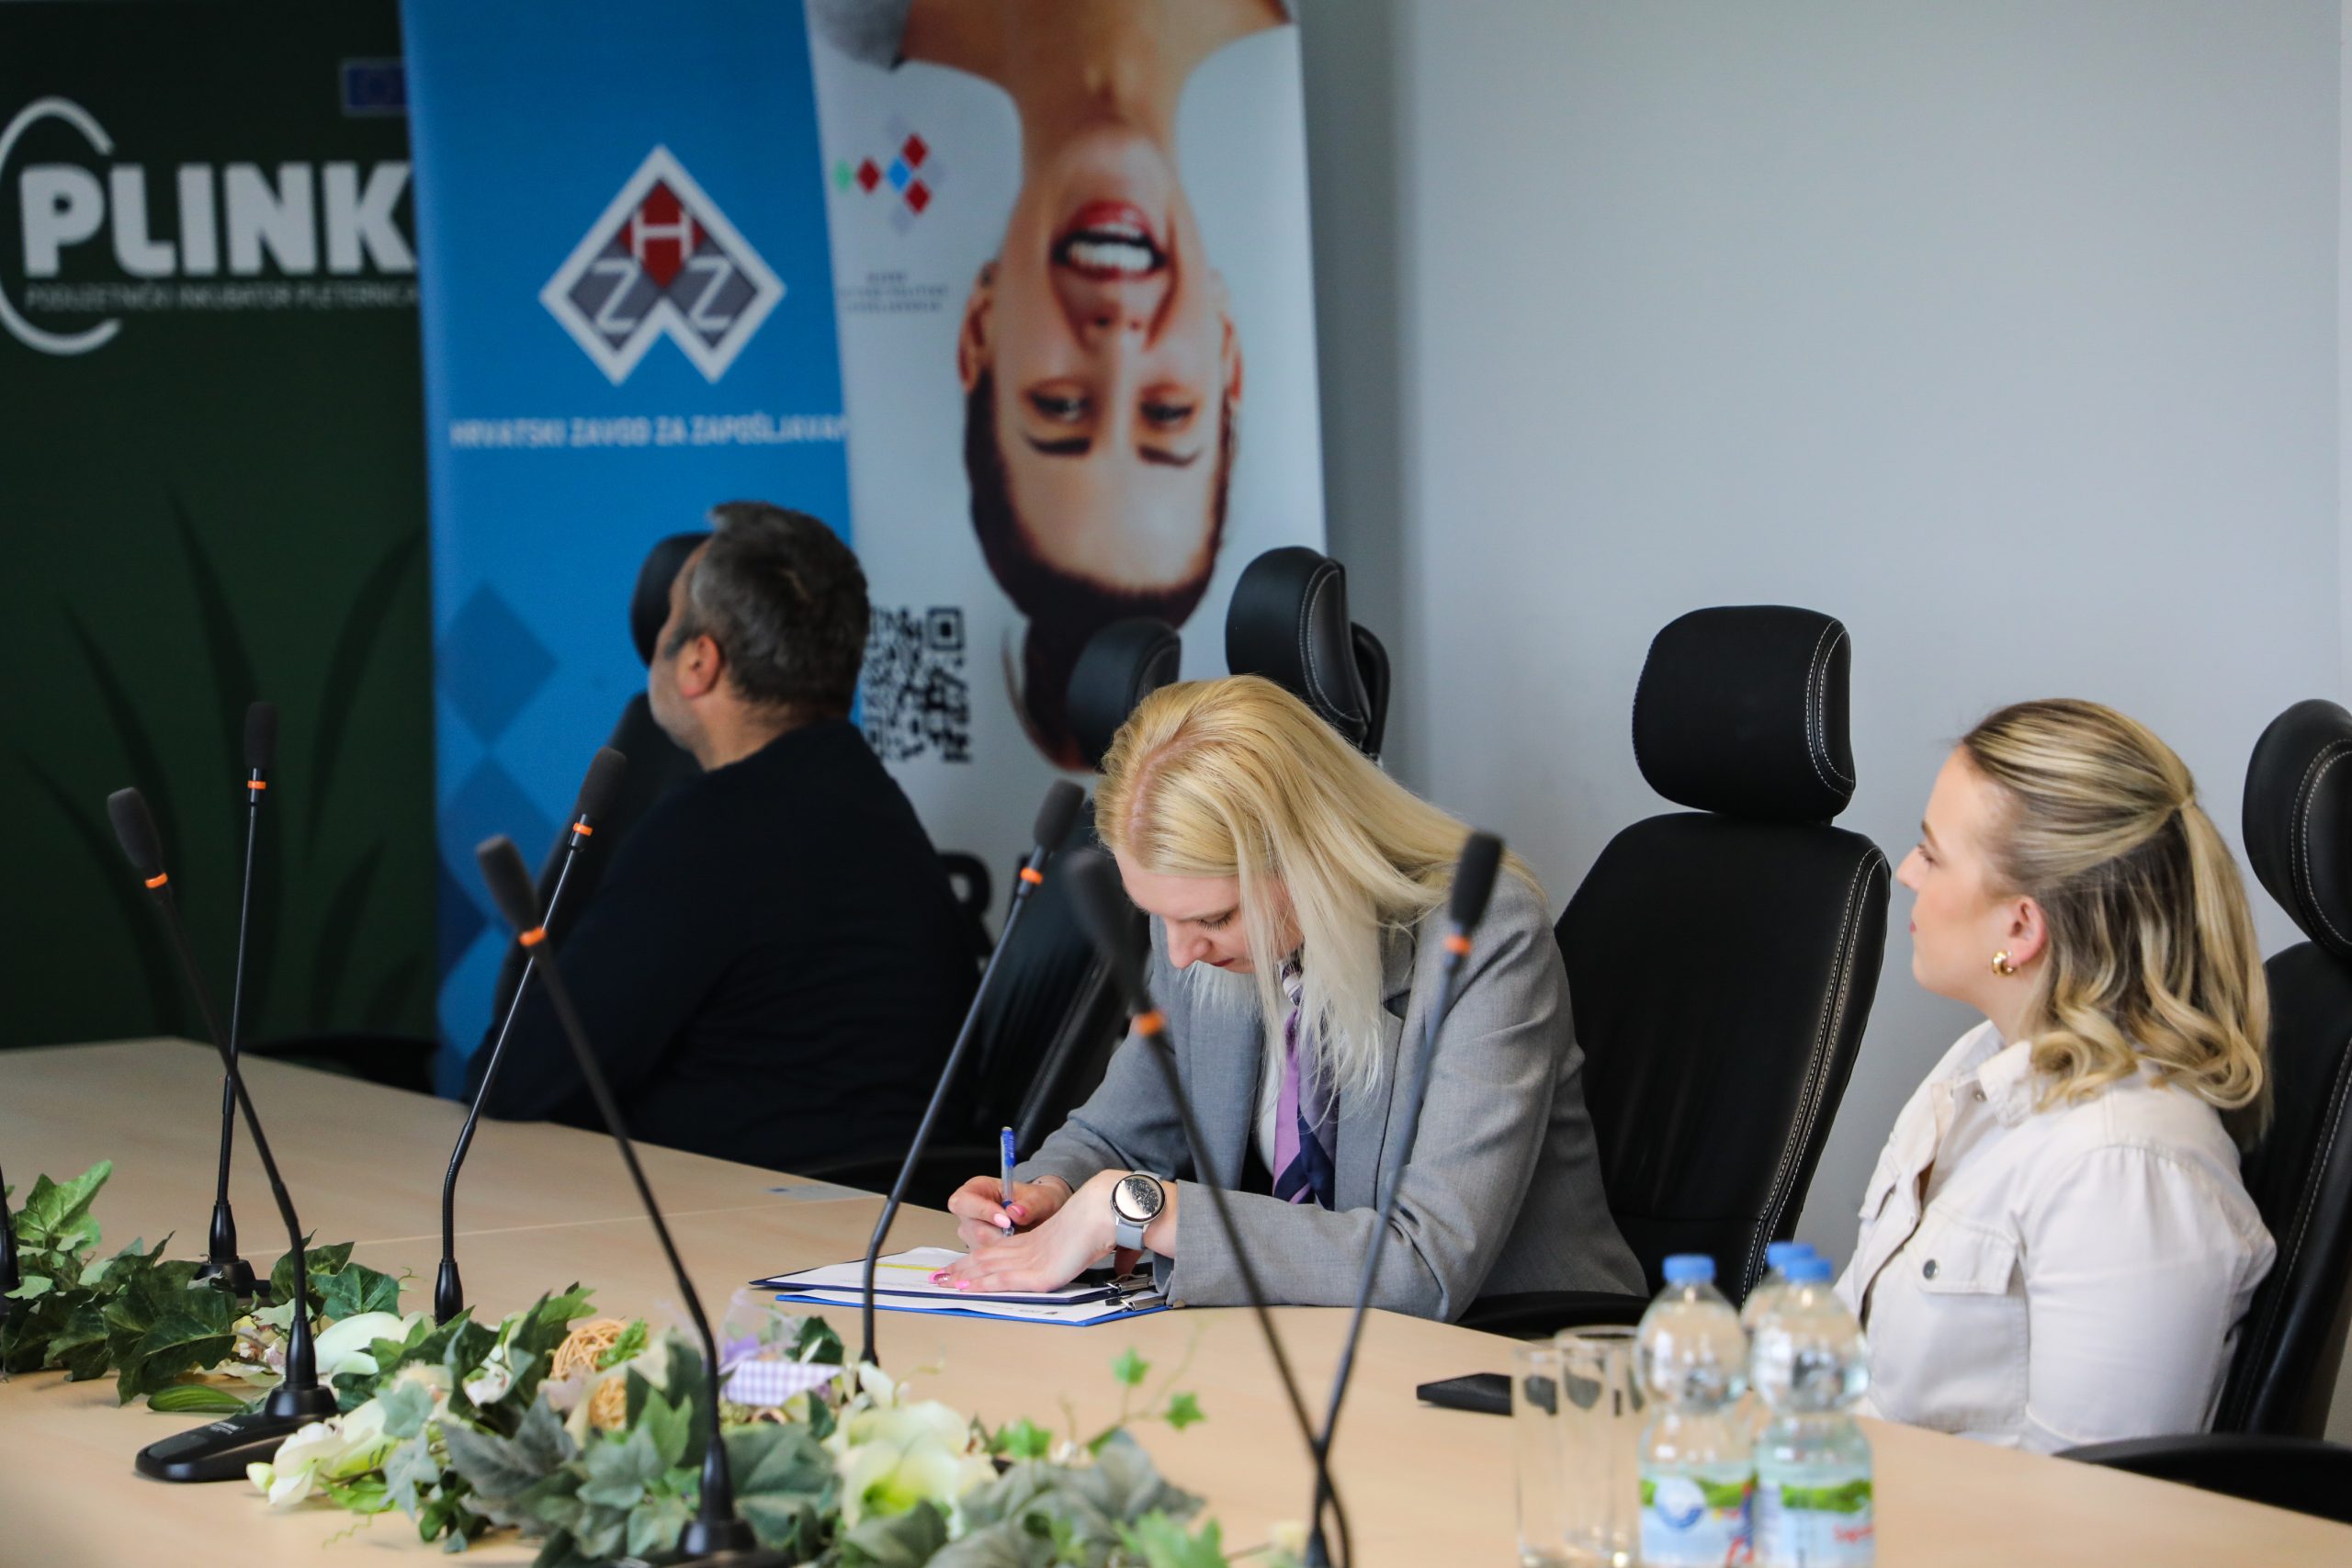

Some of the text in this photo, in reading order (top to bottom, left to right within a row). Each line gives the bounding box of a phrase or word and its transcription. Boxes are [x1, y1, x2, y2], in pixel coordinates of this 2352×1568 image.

[19, 160, 418, 276] PLINK
[571, 415, 650, 447] ZAVOD
[654, 414, 689, 446] ZA
